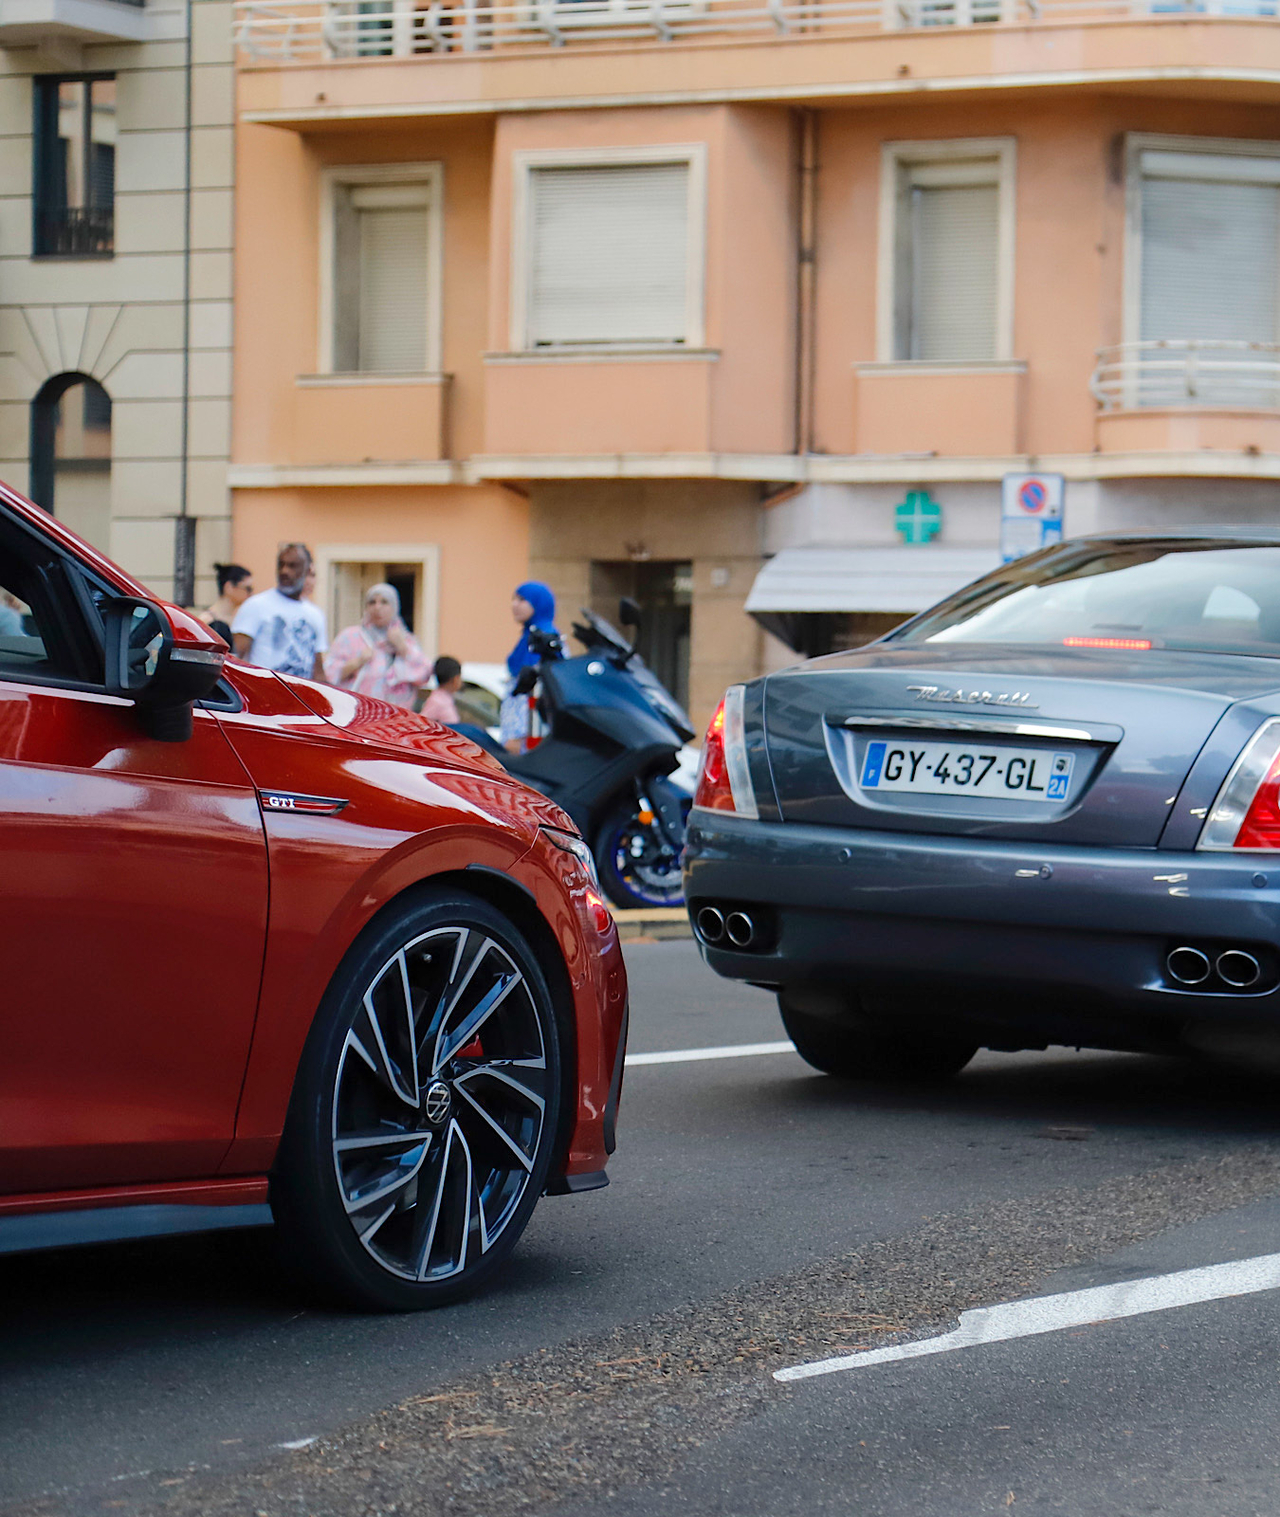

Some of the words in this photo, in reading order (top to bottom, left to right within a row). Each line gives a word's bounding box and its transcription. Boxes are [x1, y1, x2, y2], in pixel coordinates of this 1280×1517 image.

[906, 685, 1040, 709] Maserati
[884, 749, 1045, 792] GY-437-GL
[1048, 778, 1067, 797] 2A
[268, 796, 296, 808] GTI
